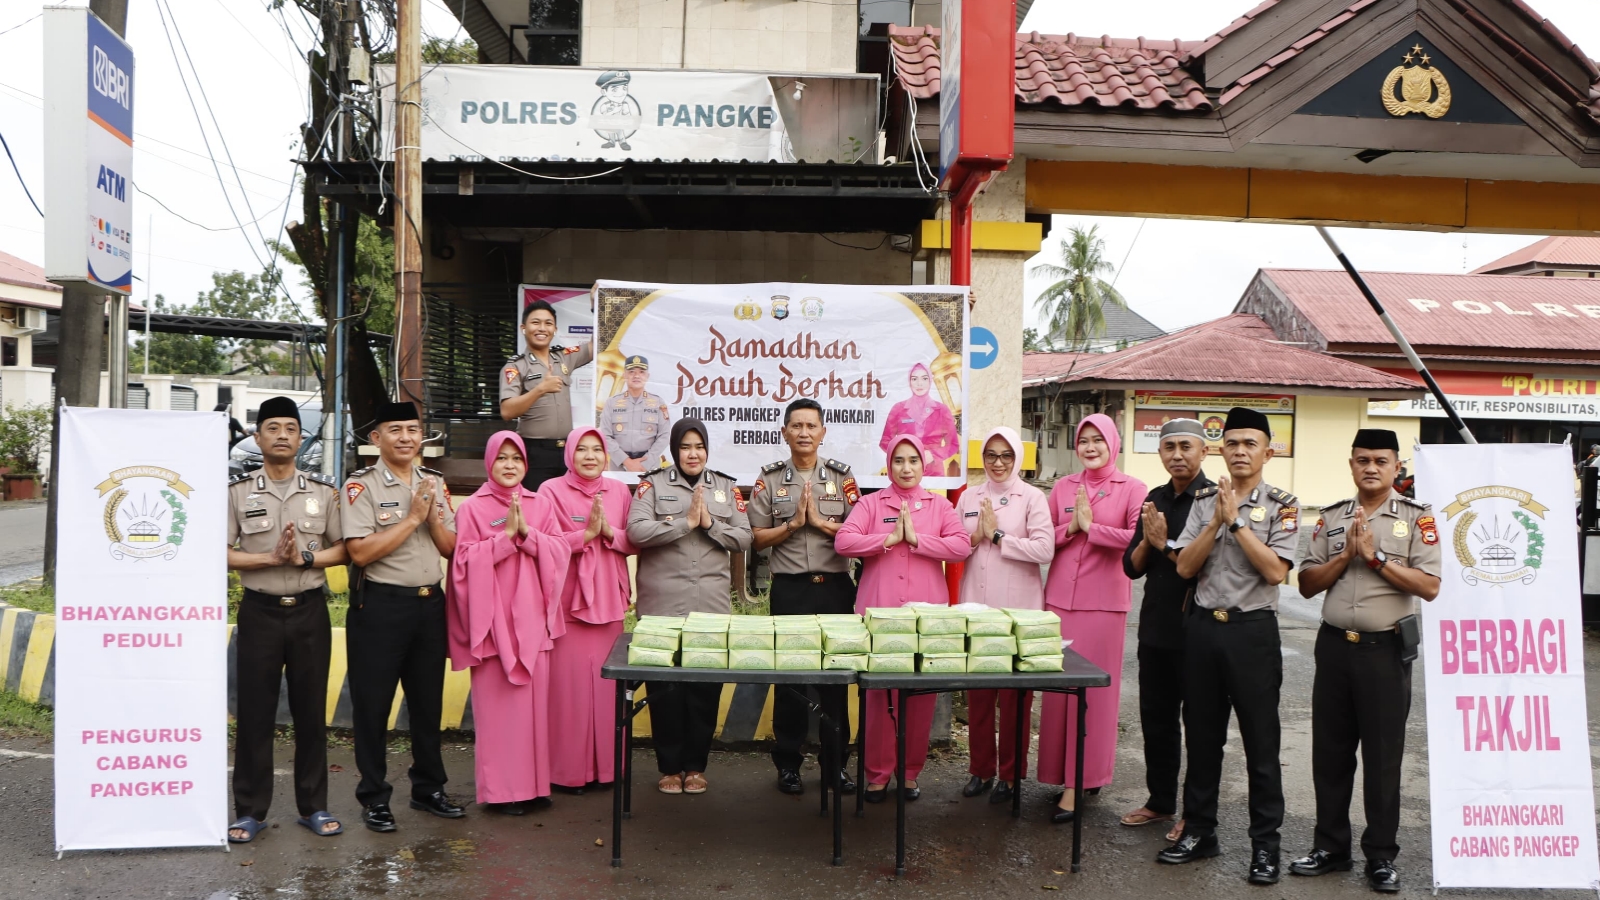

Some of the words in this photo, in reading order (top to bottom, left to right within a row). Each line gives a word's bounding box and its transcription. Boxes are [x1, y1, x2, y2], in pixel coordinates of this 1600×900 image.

[108, 60, 129, 110] BRI
[460, 101, 577, 126] POLRES
[97, 164, 126, 202] ATM
[698, 324, 861, 367] Ramadhan
[671, 361, 769, 404] Penuh
[772, 361, 887, 403] Berkah
[683, 406, 726, 422] POLRES
[729, 407, 781, 422] PANGKEP
[1411, 400, 1479, 413] PREDKTIF,
[1484, 401, 1598, 417] RESPONSIBILITAS,
[733, 429, 781, 445] BERBAGI
[114, 467, 176, 480] BHAYANGKARI
[1460, 487, 1527, 502] BHAYANGKARI
[117, 545, 145, 556] KEMALA
[1470, 568, 1501, 581] KEMALA
[1501, 568, 1529, 581] HIKMAH
[61, 605, 223, 622] BHAYANGKARI
[103, 632, 183, 649] PEDULI
[1439, 618, 1567, 675] BERBAGI
[1455, 695, 1561, 752] TAKJIL
[81, 727, 202, 745] PENGURUS
[96, 754, 188, 772] CABANG
[90, 780, 194, 798] PANGKEP
[1462, 804, 1564, 827] BHAYANGKARI
[1449, 835, 1510, 858] CABANG
[1514, 835, 1579, 858] PANGKEP
